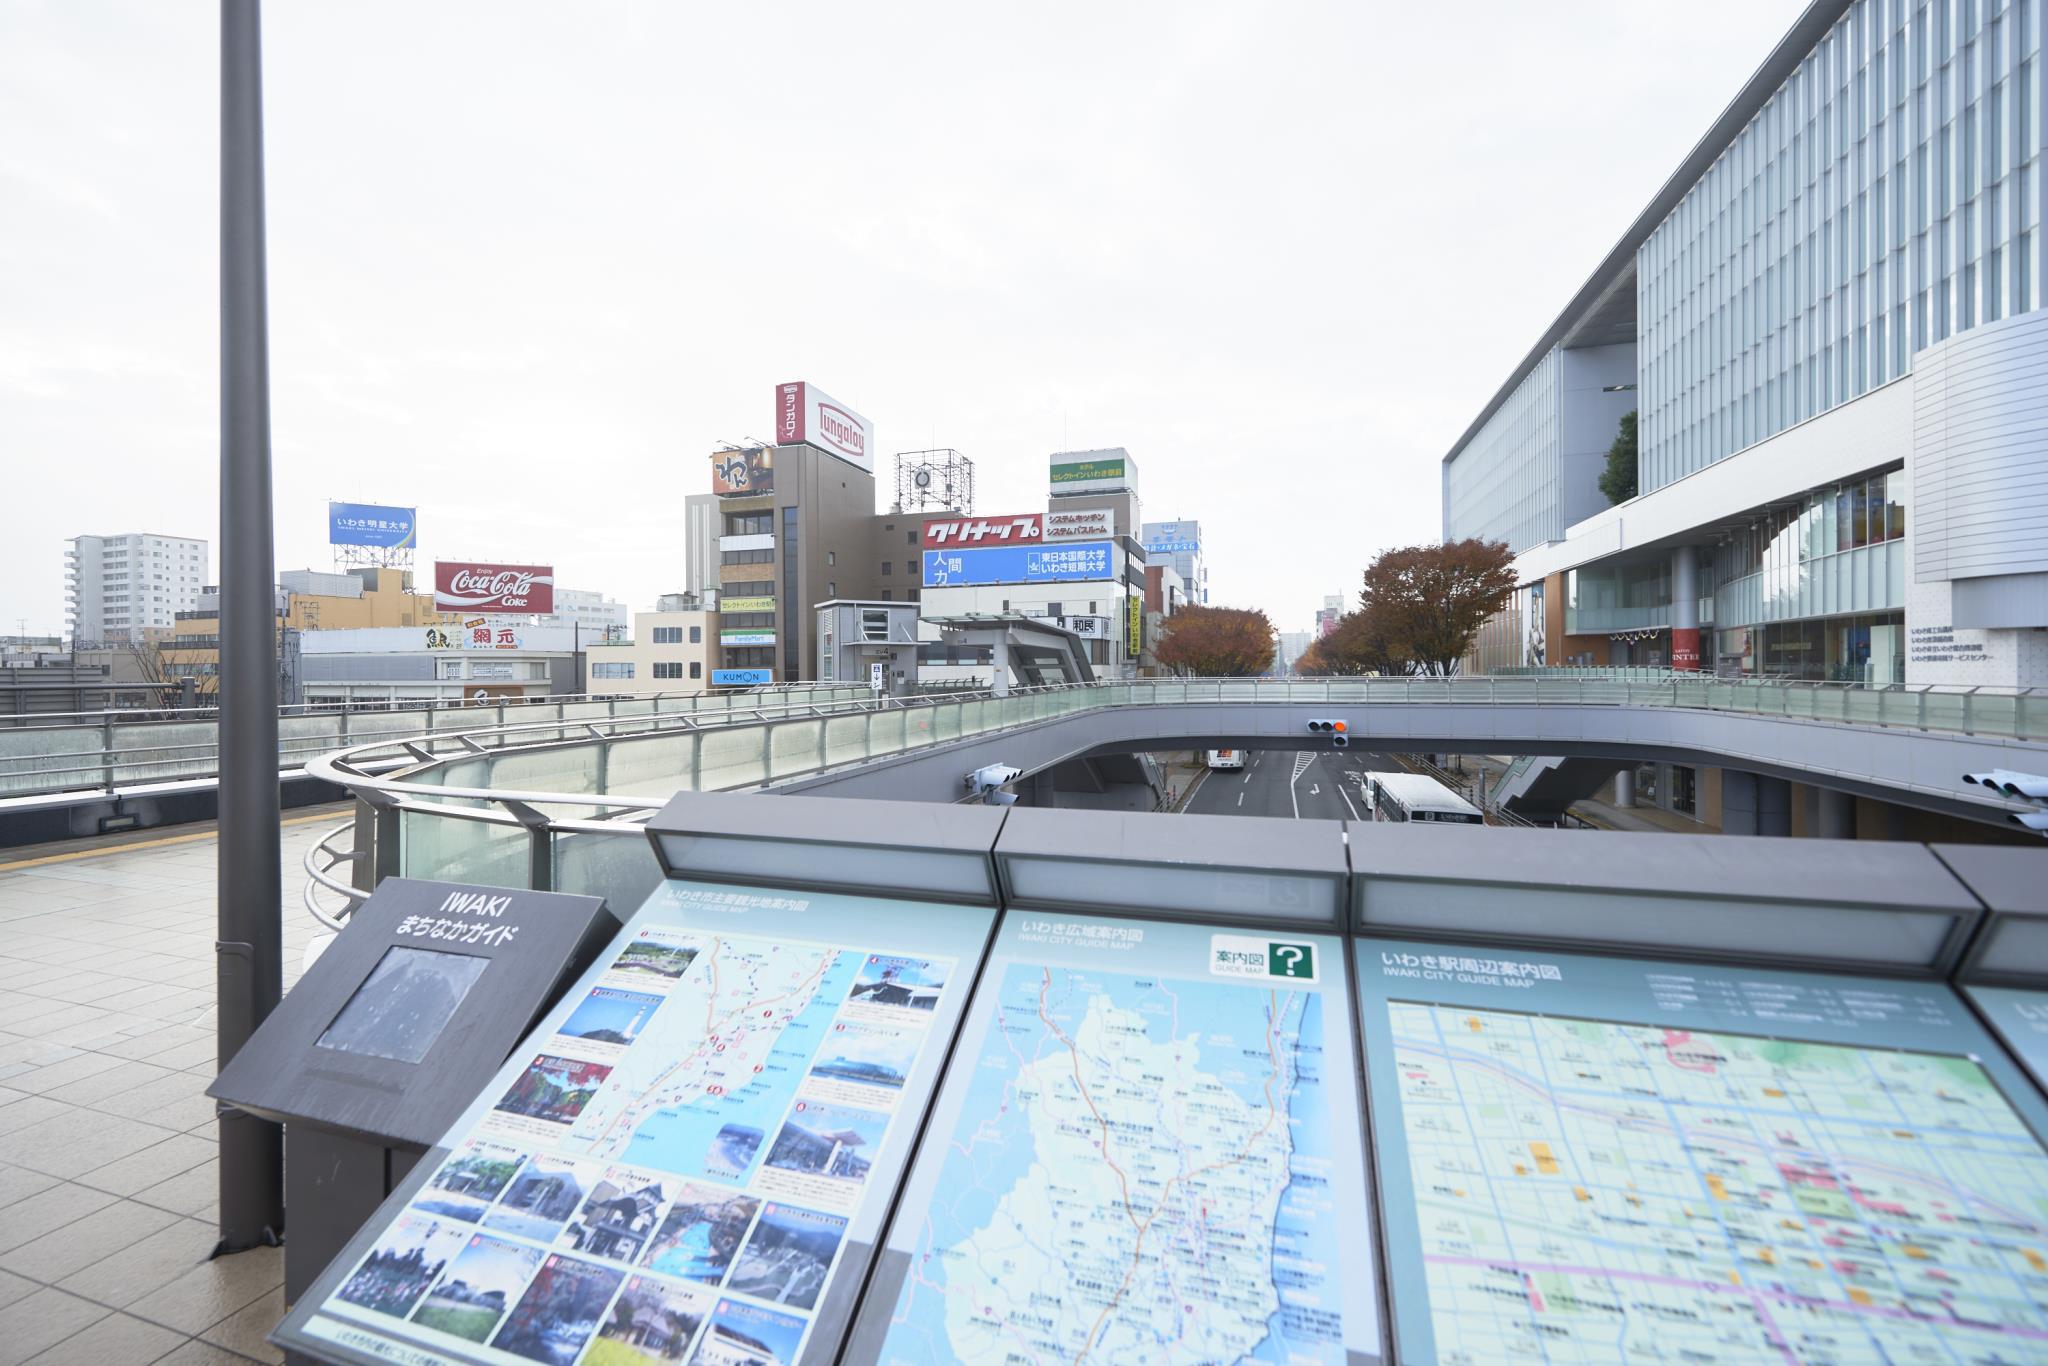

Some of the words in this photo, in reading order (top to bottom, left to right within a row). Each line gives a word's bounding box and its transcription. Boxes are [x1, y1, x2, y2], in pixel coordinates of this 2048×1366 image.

[818, 403, 864, 456] Tungaloy
[337, 518, 408, 530] いわき明星大学
[928, 518, 1040, 543] クリナップ
[1041, 550, 1106, 564] 東日本国際大学
[1041, 561, 1106, 575] いわき短期大学
[450, 570, 533, 596] Coca-Cola
[502, 595, 528, 607] Coke
[1074, 619, 1094, 632] 和民
[473, 628, 515, 644] 網元
[723, 672, 759, 683] KUMON
[440, 891, 512, 918] IWAKI
[396, 915, 519, 947] まちなかガイド
[1020, 920, 1145, 943] いわき広域案内図
[1074, 936, 1108, 949] GUIDE
[1109, 938, 1135, 951] MAP
[1215, 949, 1265, 967] 案内図
[1381, 952, 1562, 981] いわき駅周辺案内図
[1214, 963, 1246, 974] GUIDE
[1246, 965, 1264, 975] MAP
[1383, 967, 1421, 978] IWAKI
[1423, 970, 1454, 981] CITY
[1456, 973, 1502, 987] GUIDE
[1503, 977, 1536, 989] MAP
